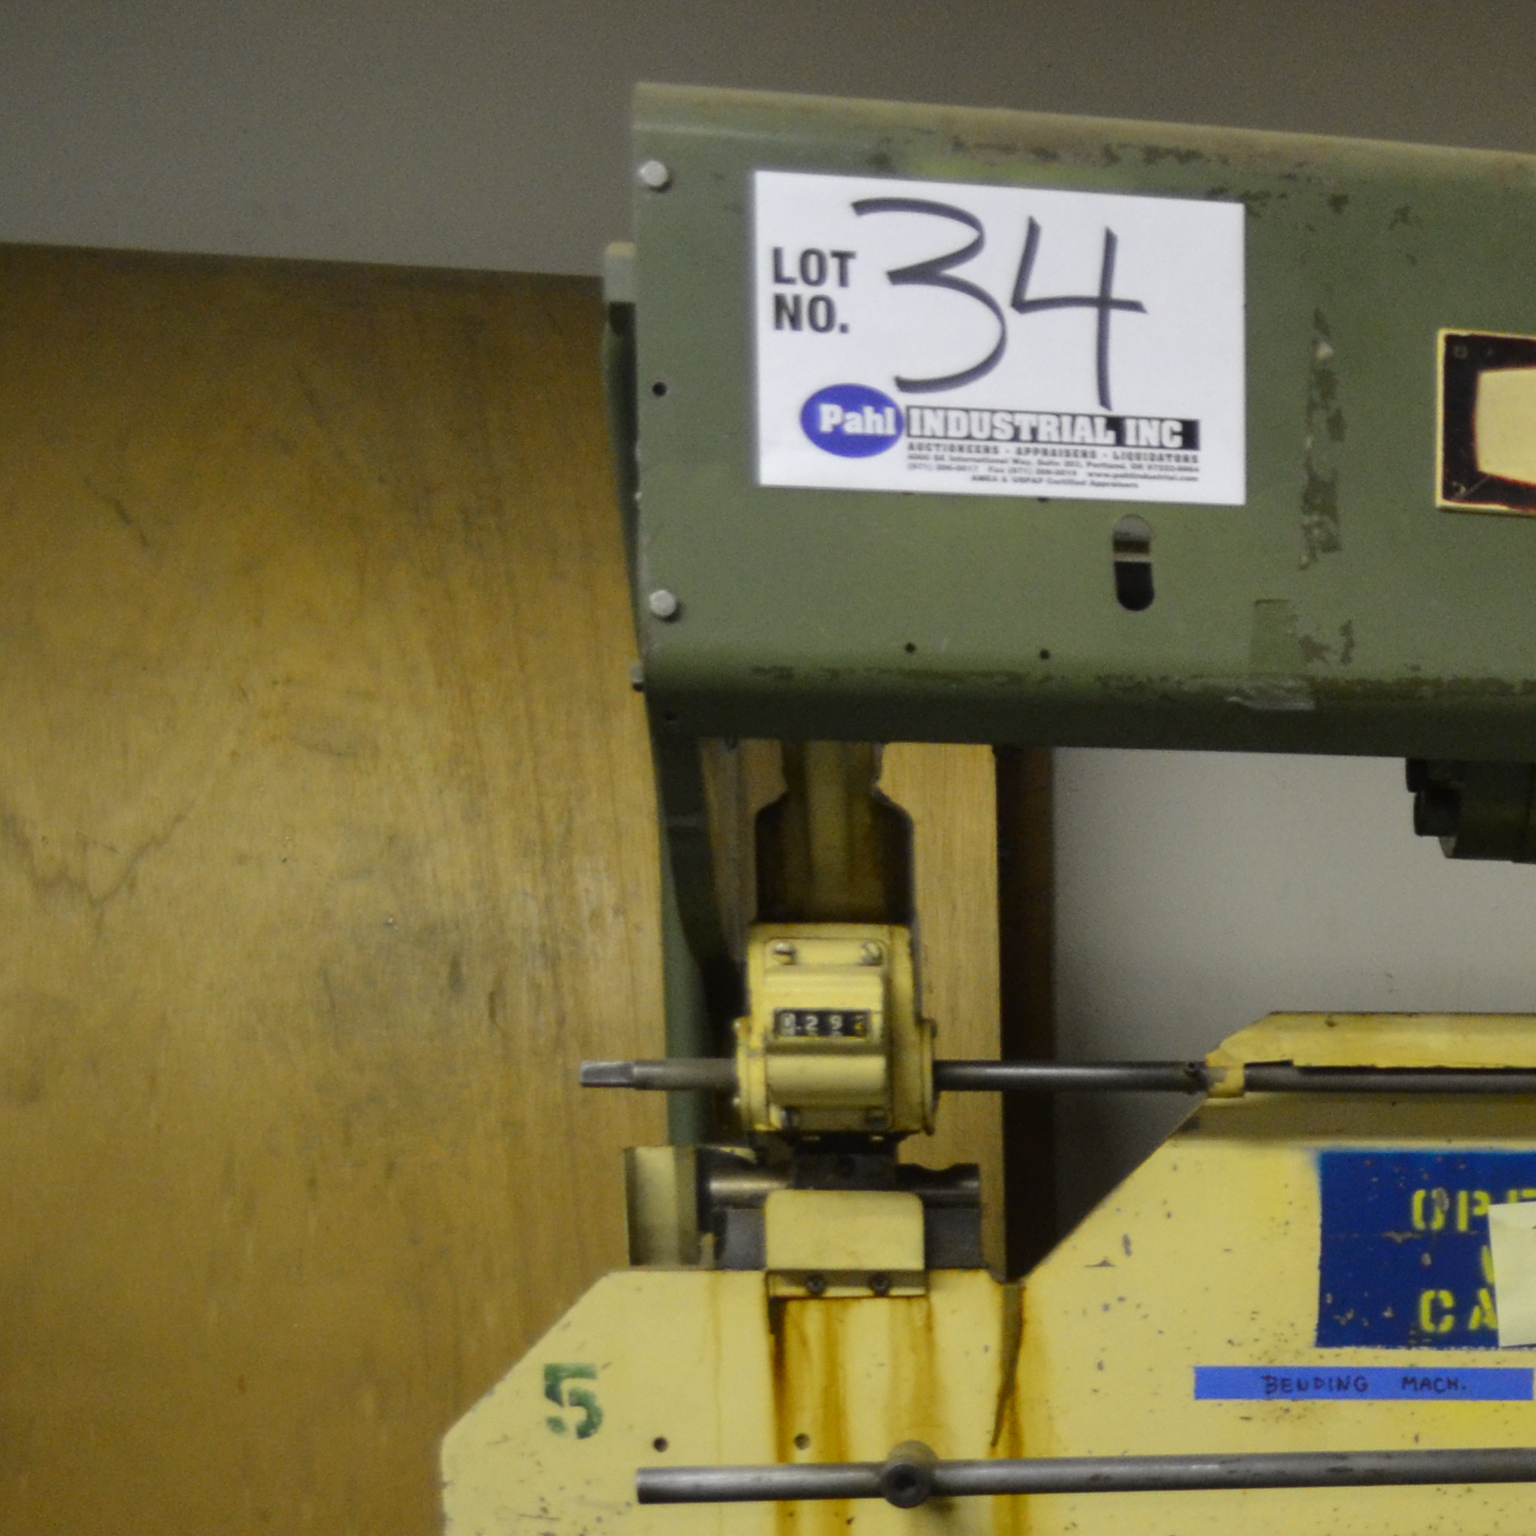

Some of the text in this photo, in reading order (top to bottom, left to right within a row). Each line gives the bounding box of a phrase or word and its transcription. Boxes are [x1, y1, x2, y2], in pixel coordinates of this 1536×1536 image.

[771, 246, 857, 288] LOT
[773, 293, 850, 334] NO.
[851, 196, 1149, 412] 34
[817, 402, 1184, 449] Pahl INDUSTRIAL INC
[907, 441, 1199, 464] AUCTIONEERS APPRAISERS LIQUIDATORS
[543, 1362, 604, 1439] 5
